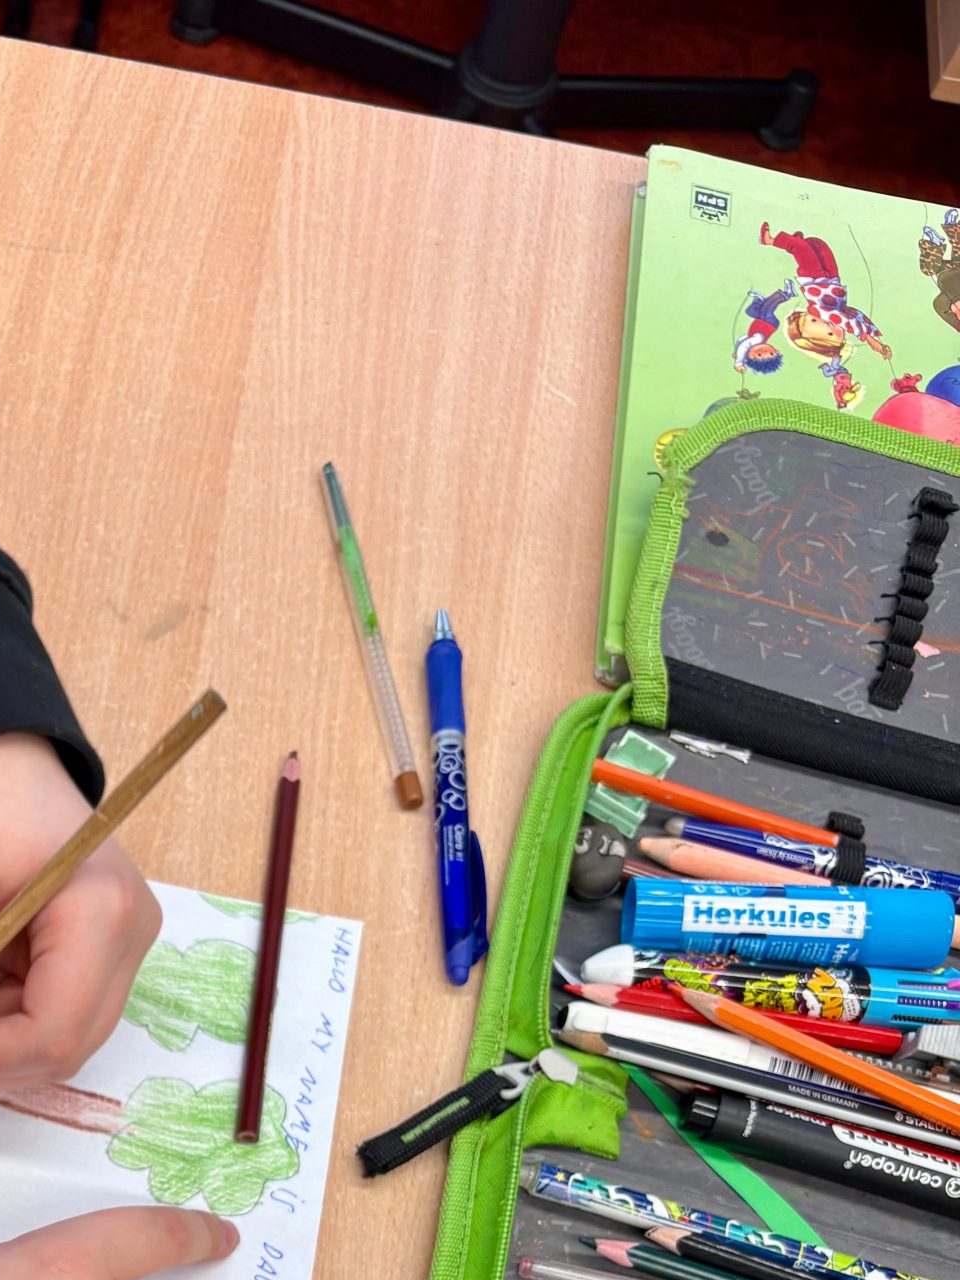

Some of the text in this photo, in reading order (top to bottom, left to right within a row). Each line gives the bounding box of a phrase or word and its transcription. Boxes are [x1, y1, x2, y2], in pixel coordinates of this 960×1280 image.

[697, 193, 726, 208] SPN
[328, 926, 353, 993] HALLO
[311, 1012, 334, 1053] MY
[285, 1066, 317, 1151] NAME
[788, 1085, 860, 1110] MADE IN GERMANY
